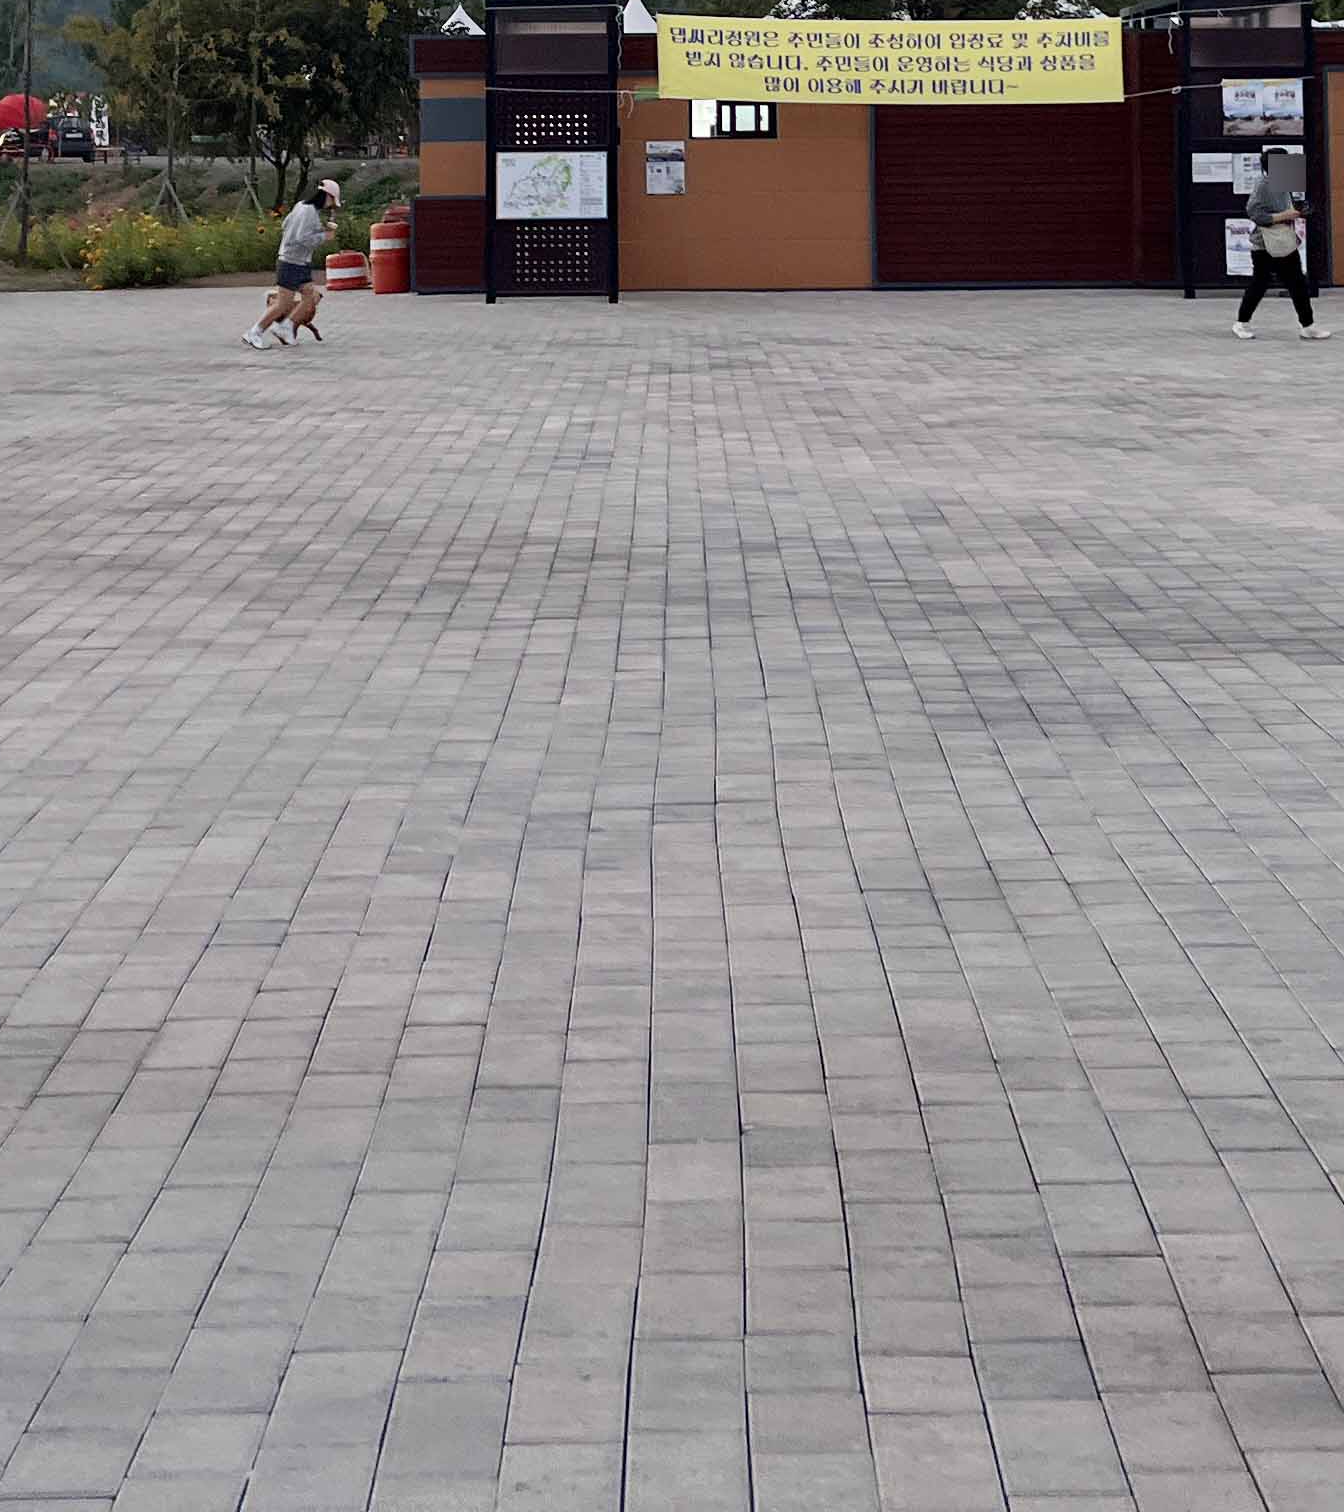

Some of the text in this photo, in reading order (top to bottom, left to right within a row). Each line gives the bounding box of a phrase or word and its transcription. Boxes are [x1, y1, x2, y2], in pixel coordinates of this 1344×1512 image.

[788, 31, 860, 49] 주민들이
[949, 32, 1003, 50] 입장료
[1011, 32, 1029, 49] 및
[1037, 30, 1110, 49] 주차비를
[685, 50, 1095, 73] 받지 않습니다. 주민들이 운영하는 식당과 상품을
[764, 76, 800, 93] 많이
[807, 78, 862, 94] 이용해
[869, 78, 924, 95] 주시기
